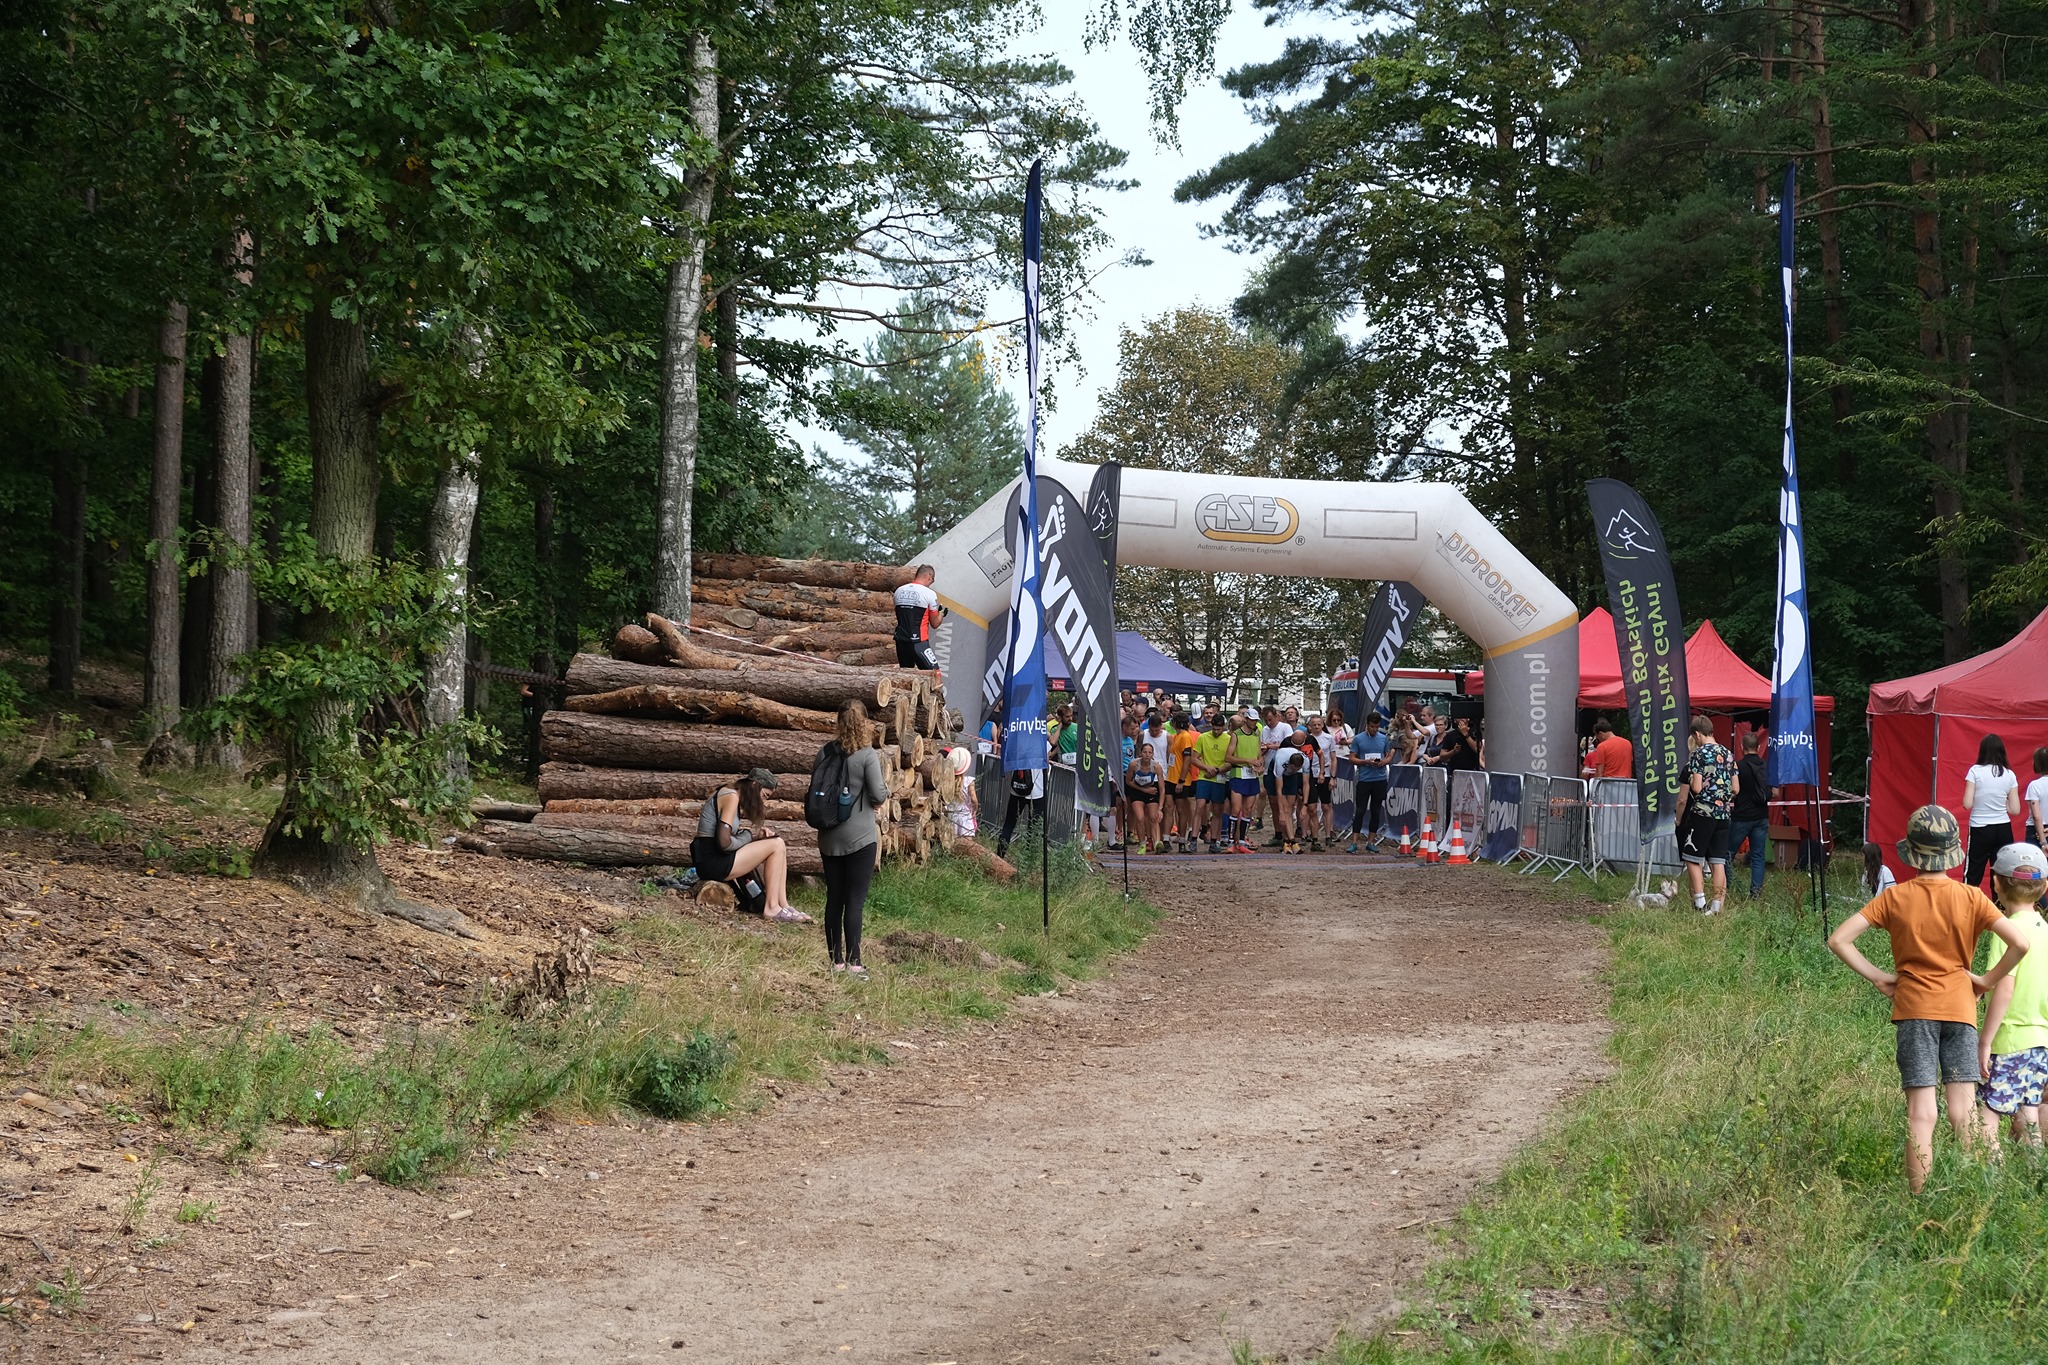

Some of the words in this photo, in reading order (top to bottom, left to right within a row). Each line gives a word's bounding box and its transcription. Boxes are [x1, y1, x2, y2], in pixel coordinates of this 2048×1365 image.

[1195, 493, 1281, 534] ASE
[1197, 543, 1229, 552] Automatic
[1230, 545, 1255, 553] Systems
[1256, 547, 1292, 556] Engineering
[1445, 530, 1538, 617] BIPRORAF
[1503, 609, 1515, 620] ASE
[1363, 616, 1404, 703] INOV
[1387, 787, 1419, 817] GDYNIA
